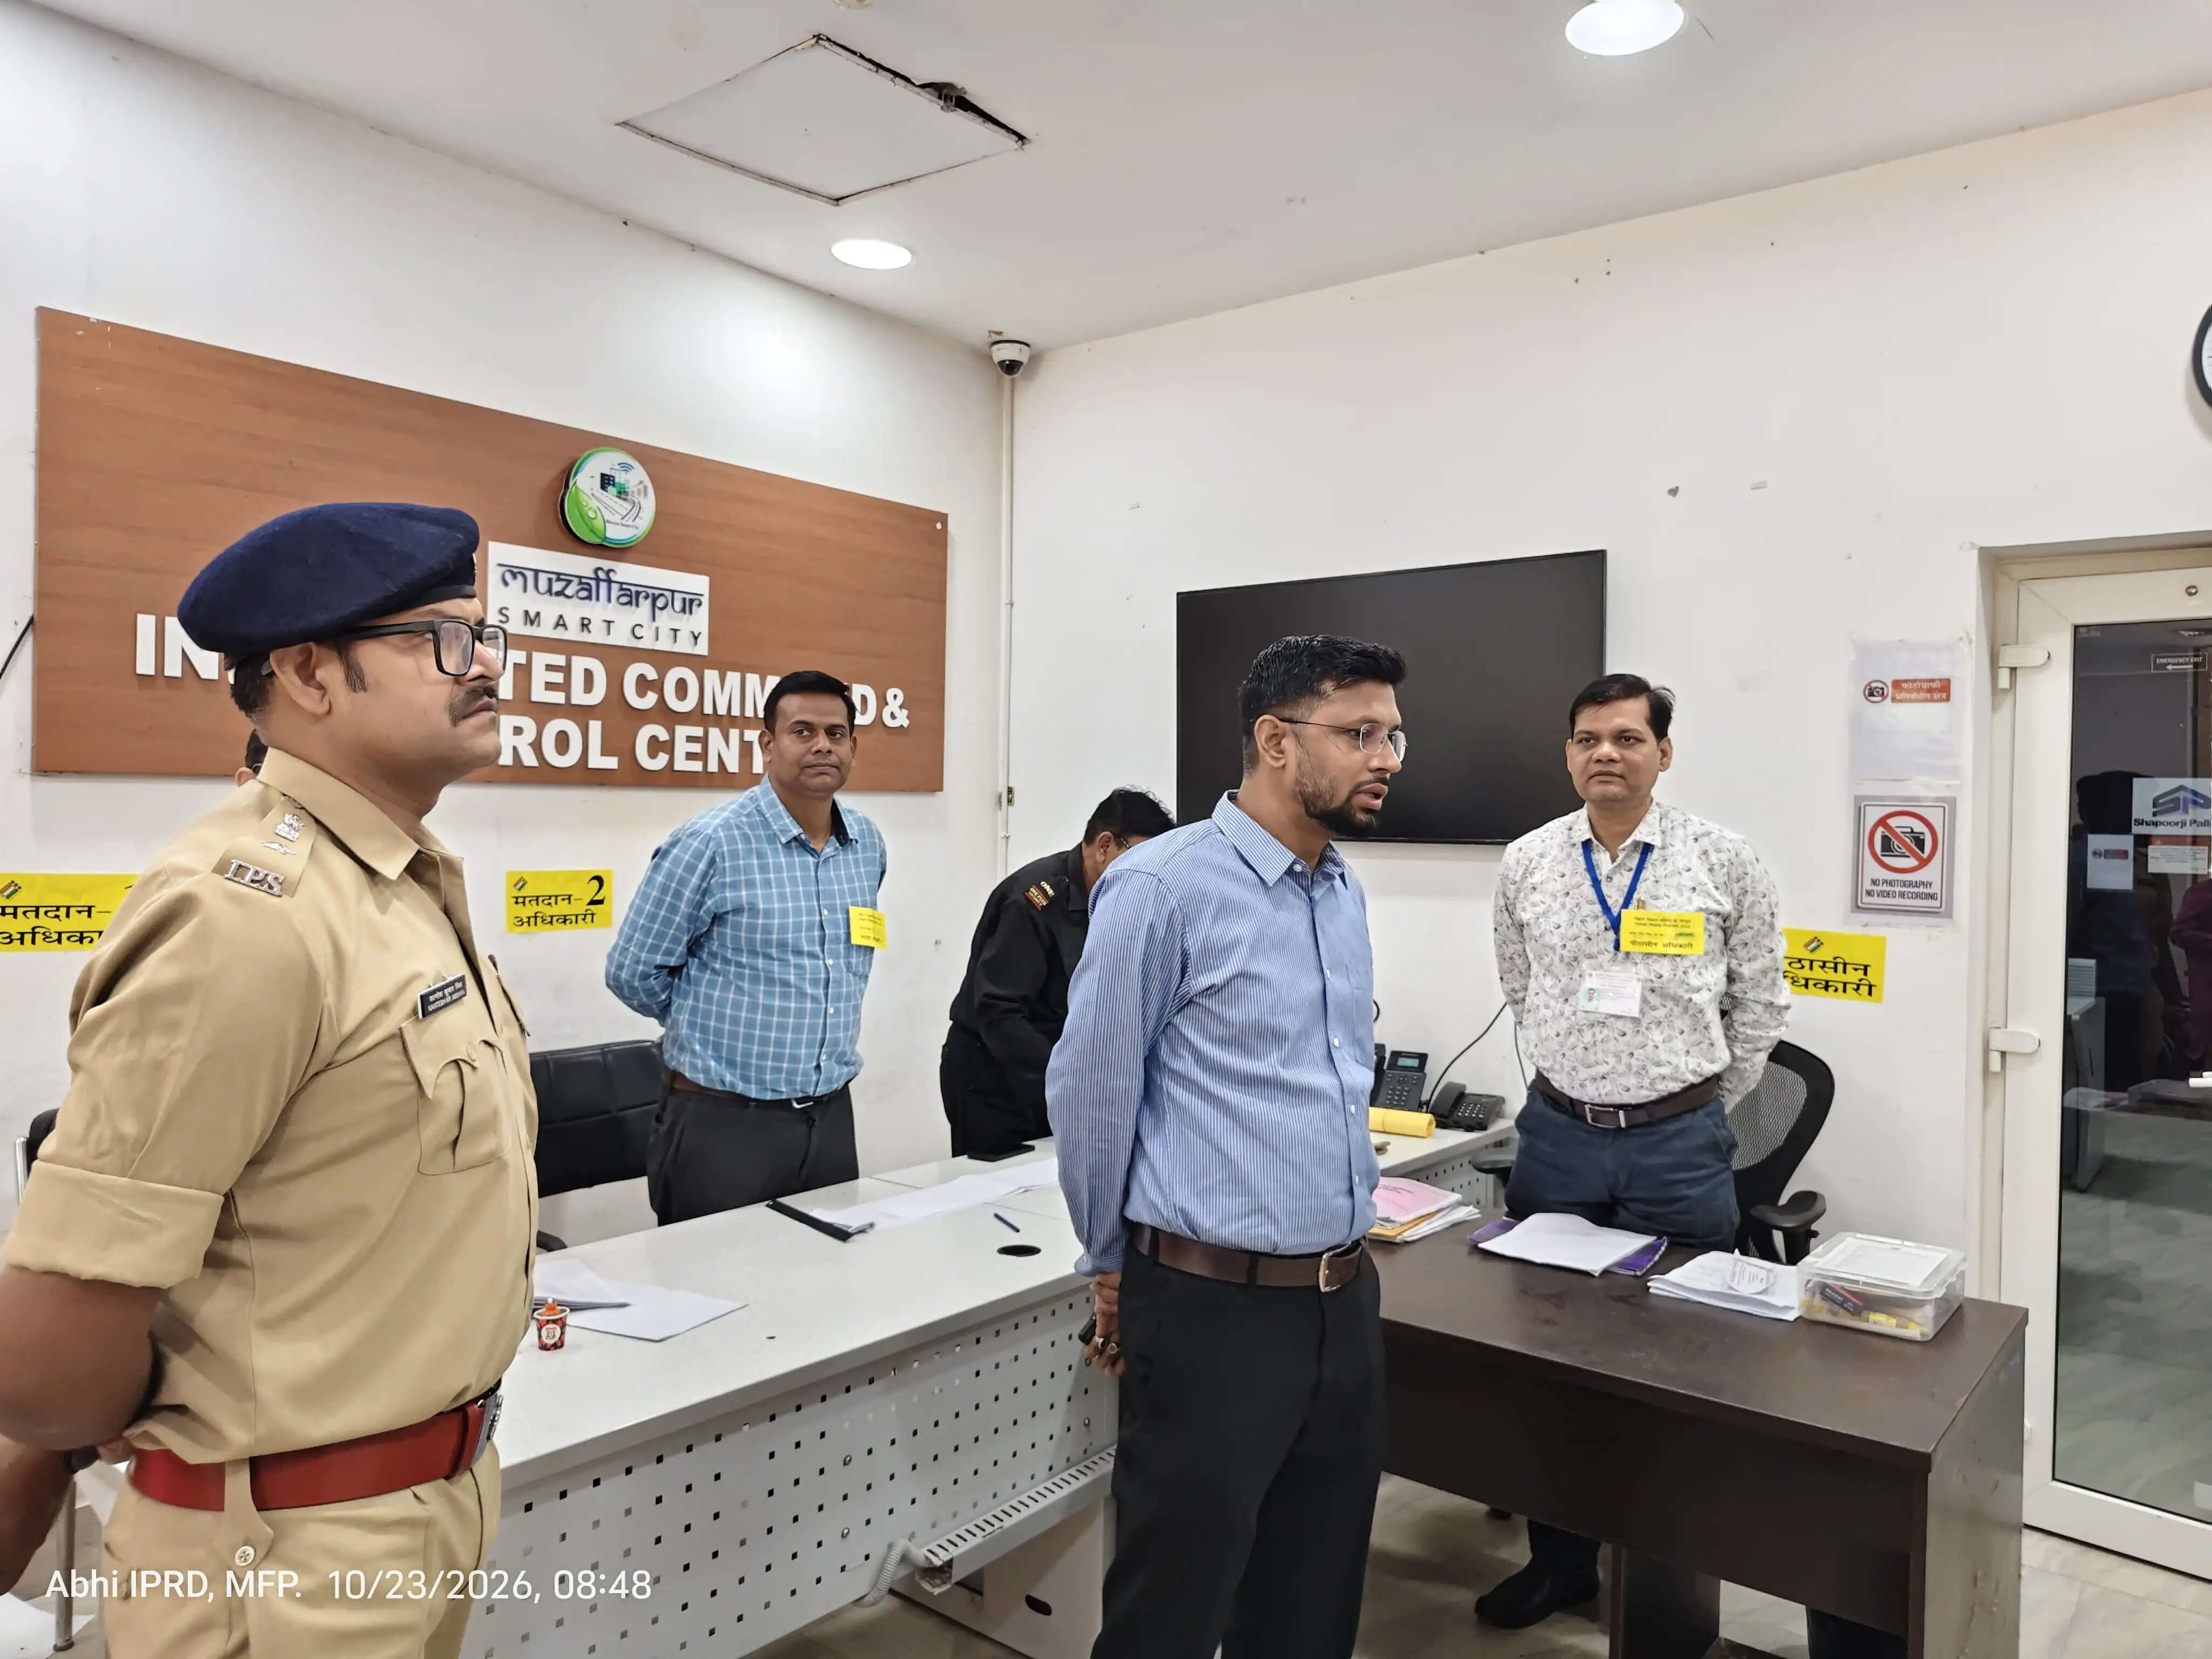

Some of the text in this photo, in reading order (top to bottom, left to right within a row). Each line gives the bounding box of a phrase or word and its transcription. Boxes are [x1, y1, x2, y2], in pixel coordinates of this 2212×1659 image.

[497, 606, 702, 646] SMART CITY
[623, 662, 877, 725] COMMD
[635, 724, 763, 774] CENT
[2134, 818, 2187, 828] Shapoorji
[224, 860, 286, 897] IPS
[1871, 878, 1933, 889] NO PHOTOGRAPHY
[1865, 889, 1938, 901] NO VIDEO RECORDING
[513, 909, 596, 927] अधिकारी
[1784, 956, 1871, 977] ठासीन
[1783, 970, 1877, 997] धिकारी
